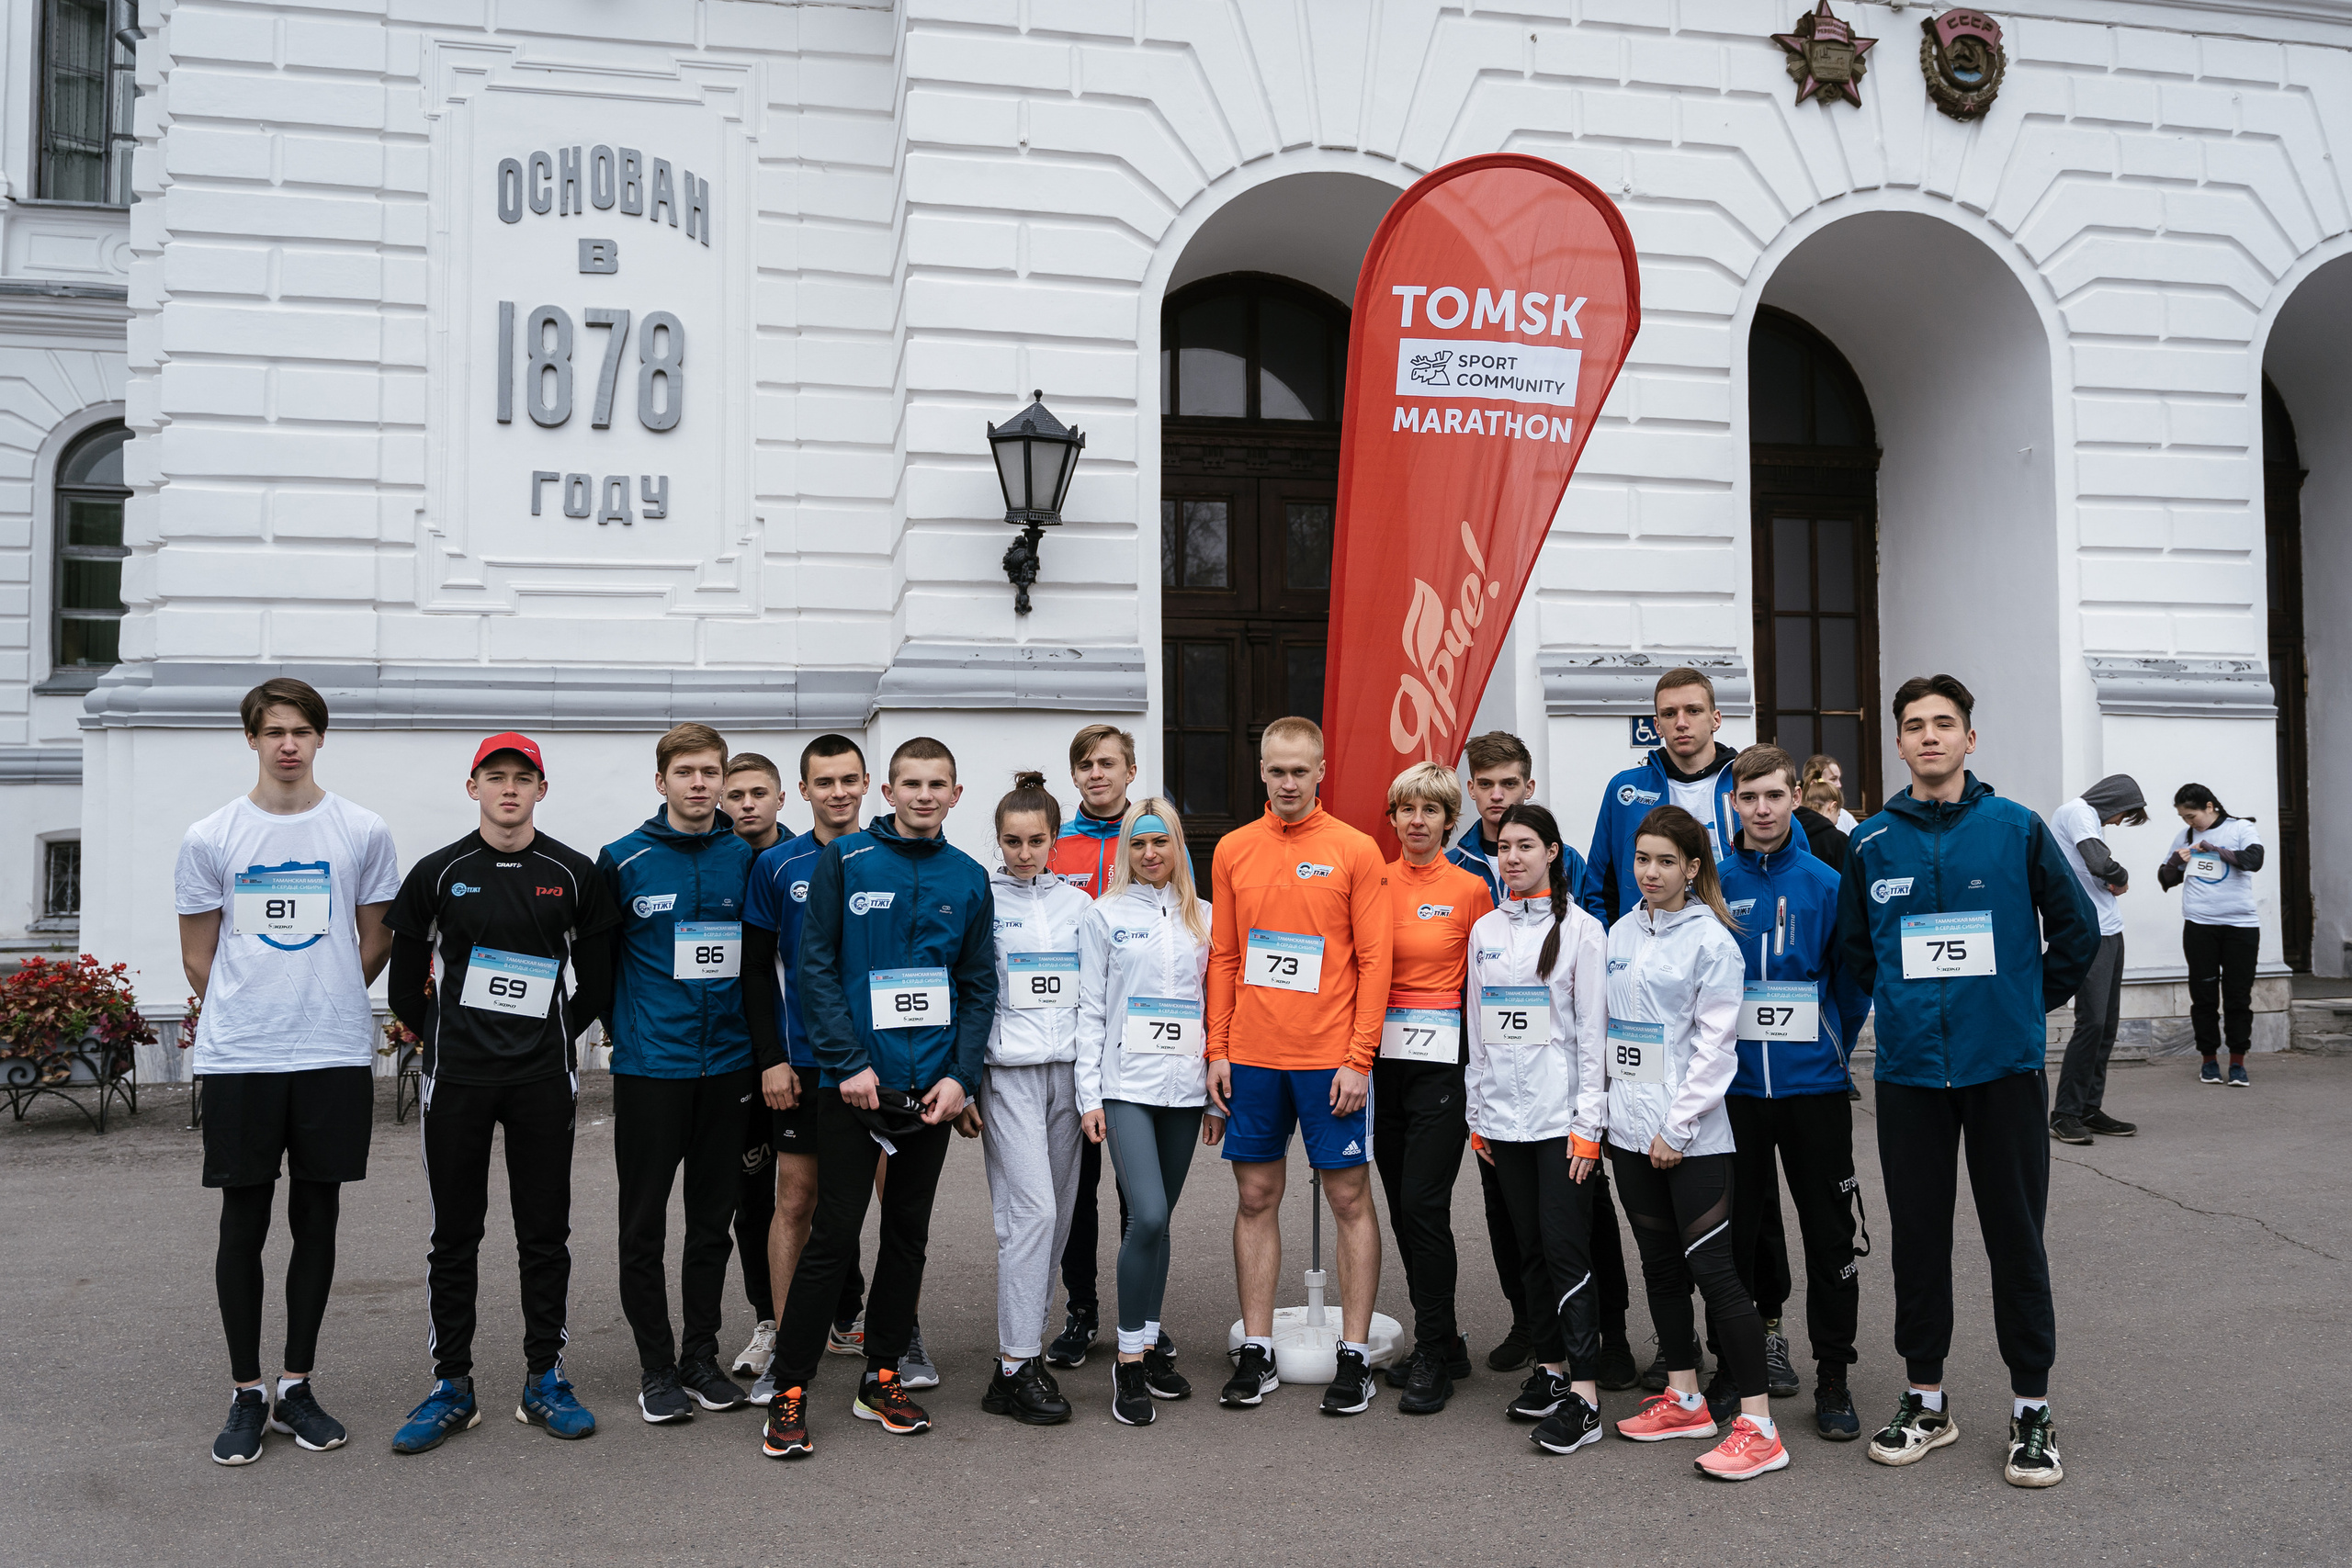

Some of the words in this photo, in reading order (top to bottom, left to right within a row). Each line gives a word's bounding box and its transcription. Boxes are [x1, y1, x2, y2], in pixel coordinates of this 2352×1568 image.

[1947, 15, 1994, 32] СССР
[497, 144, 709, 247] ОСНОВАН
[578, 238, 618, 275] В
[1392, 285, 1589, 339] TOMSK
[496, 299, 684, 432] 1878
[1458, 355, 1518, 370] SPORT
[1456, 373, 1566, 395] COMMUNITY
[1393, 406, 1573, 444] MARATHON
[531, 470, 669, 525] ГОДУ
[2198, 861, 2213, 871] 56
[266, 899, 296, 919] 81
[652, 902, 673, 910] ТТЖТ
[505, 956, 537, 965] ТАМАНСКАЯ
[695, 946, 724, 964] 86
[1927, 940, 1967, 962] 75
[528, 966, 550, 975] СИБИРИ
[1266, 954, 1299, 976] 73
[489, 976, 527, 999] 69
[1031, 976, 1060, 994] 80
[895, 992, 929, 1012] 85
[1498, 1011, 1528, 1030] 76
[1757, 1007, 1794, 1026] 87
[1148, 1021, 1181, 1041] 79
[1403, 1028, 1437, 1046] 77
[1617, 1045, 1641, 1066] 89
